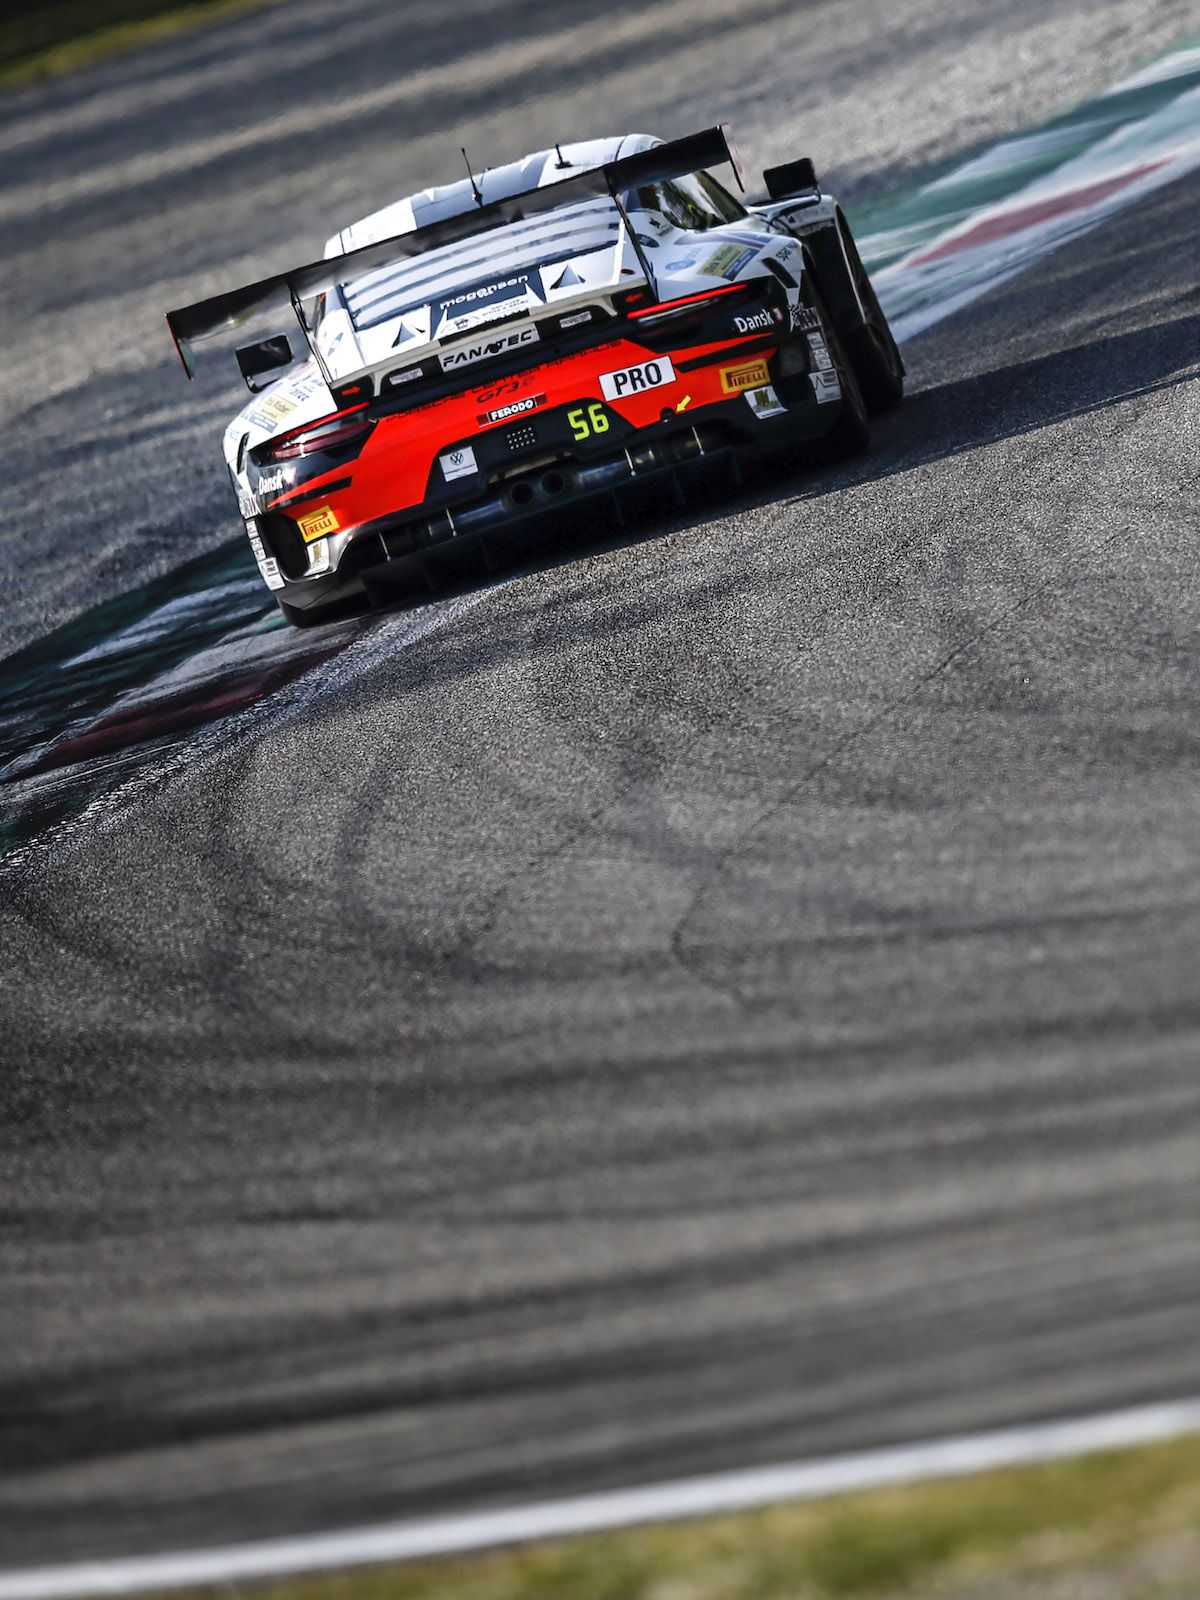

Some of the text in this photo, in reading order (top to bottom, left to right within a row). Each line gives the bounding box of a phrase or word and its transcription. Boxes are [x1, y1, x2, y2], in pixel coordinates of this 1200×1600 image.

[733, 308, 775, 333] Dansk
[443, 328, 535, 368] FANATEC
[612, 362, 663, 396] PRO
[725, 363, 767, 389] PIRELLI
[489, 398, 535, 421] FERODO
[566, 403, 610, 442] 56
[258, 468, 284, 496] Dansk
[301, 511, 333, 538] PIRELLI
